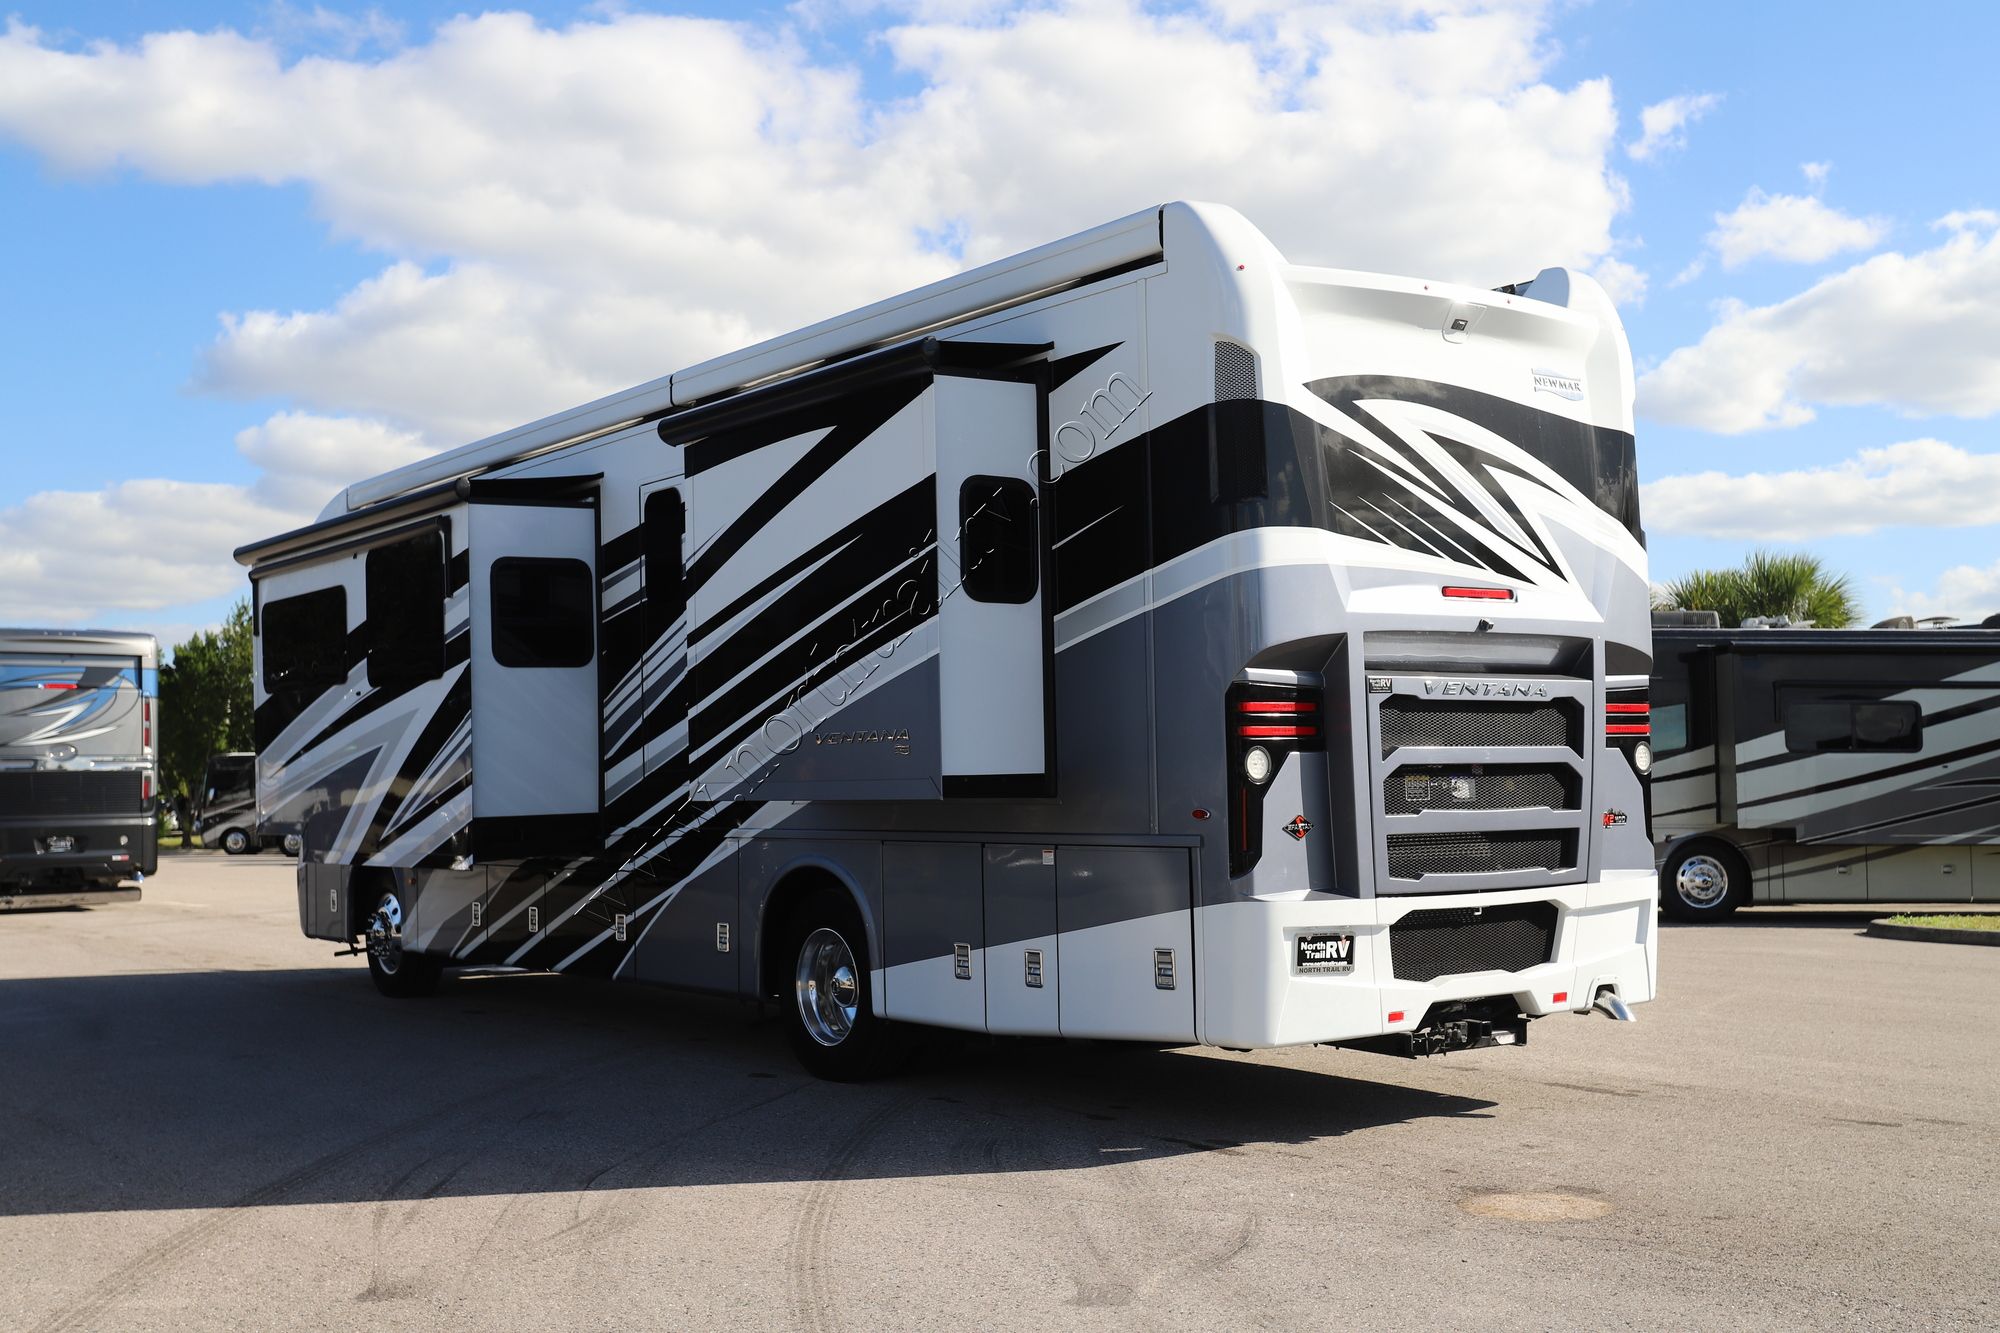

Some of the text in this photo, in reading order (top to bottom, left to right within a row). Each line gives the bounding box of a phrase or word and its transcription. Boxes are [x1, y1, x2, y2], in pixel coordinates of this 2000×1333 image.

[1533, 375, 1582, 392] NEWMAR
[1423, 680, 1549, 698] VENTANA
[815, 728, 910, 746] VENTANA
[1300, 941, 1326, 950] North
[1326, 941, 1350, 958] RV
[1305, 950, 1326, 959] Trail
